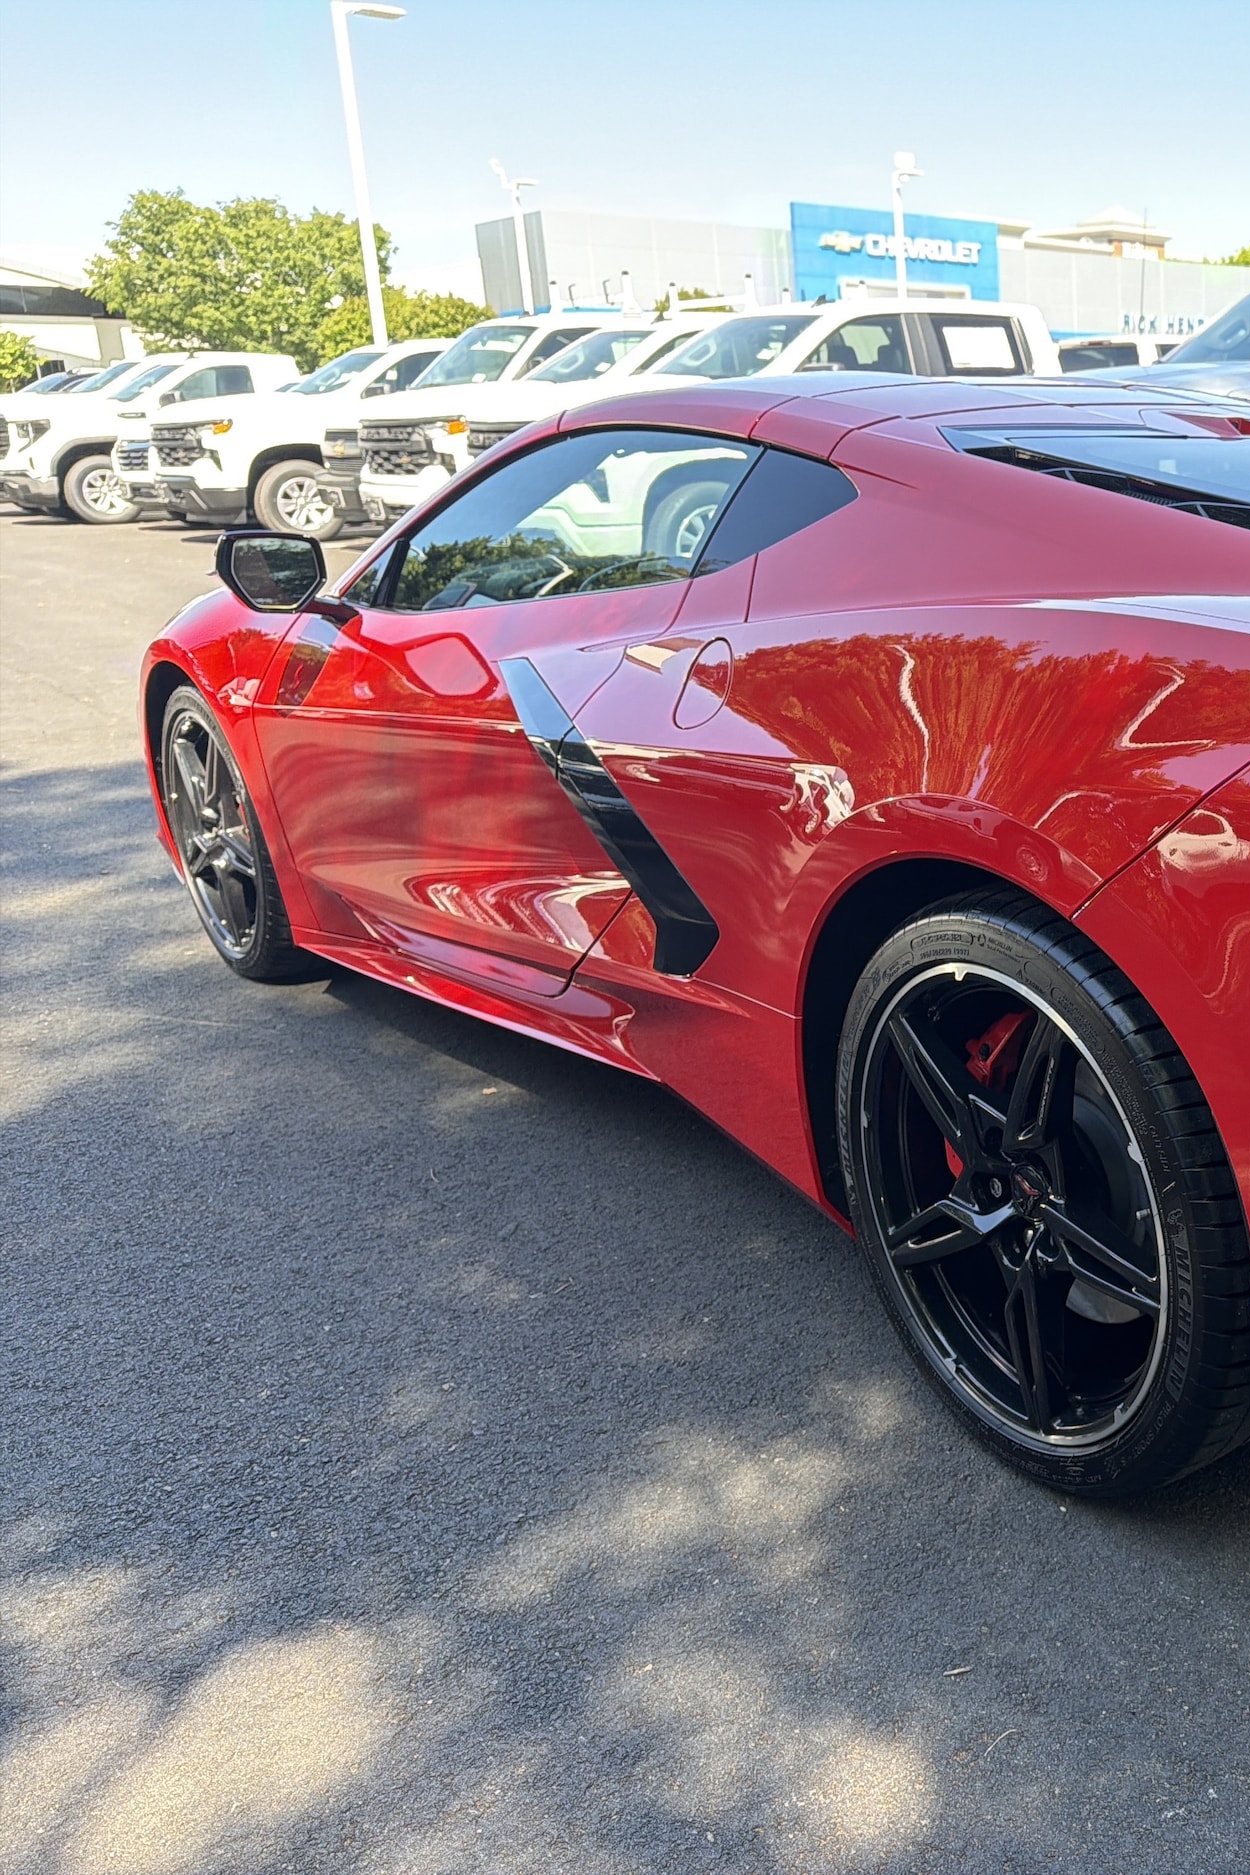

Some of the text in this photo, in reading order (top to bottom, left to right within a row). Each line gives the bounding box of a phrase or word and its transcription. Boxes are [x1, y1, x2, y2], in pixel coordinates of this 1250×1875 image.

[864, 233, 981, 265] CHEVROLET
[1122, 314, 1157, 335] RICK
[1170, 1246, 1192, 1391] MICHELIN
